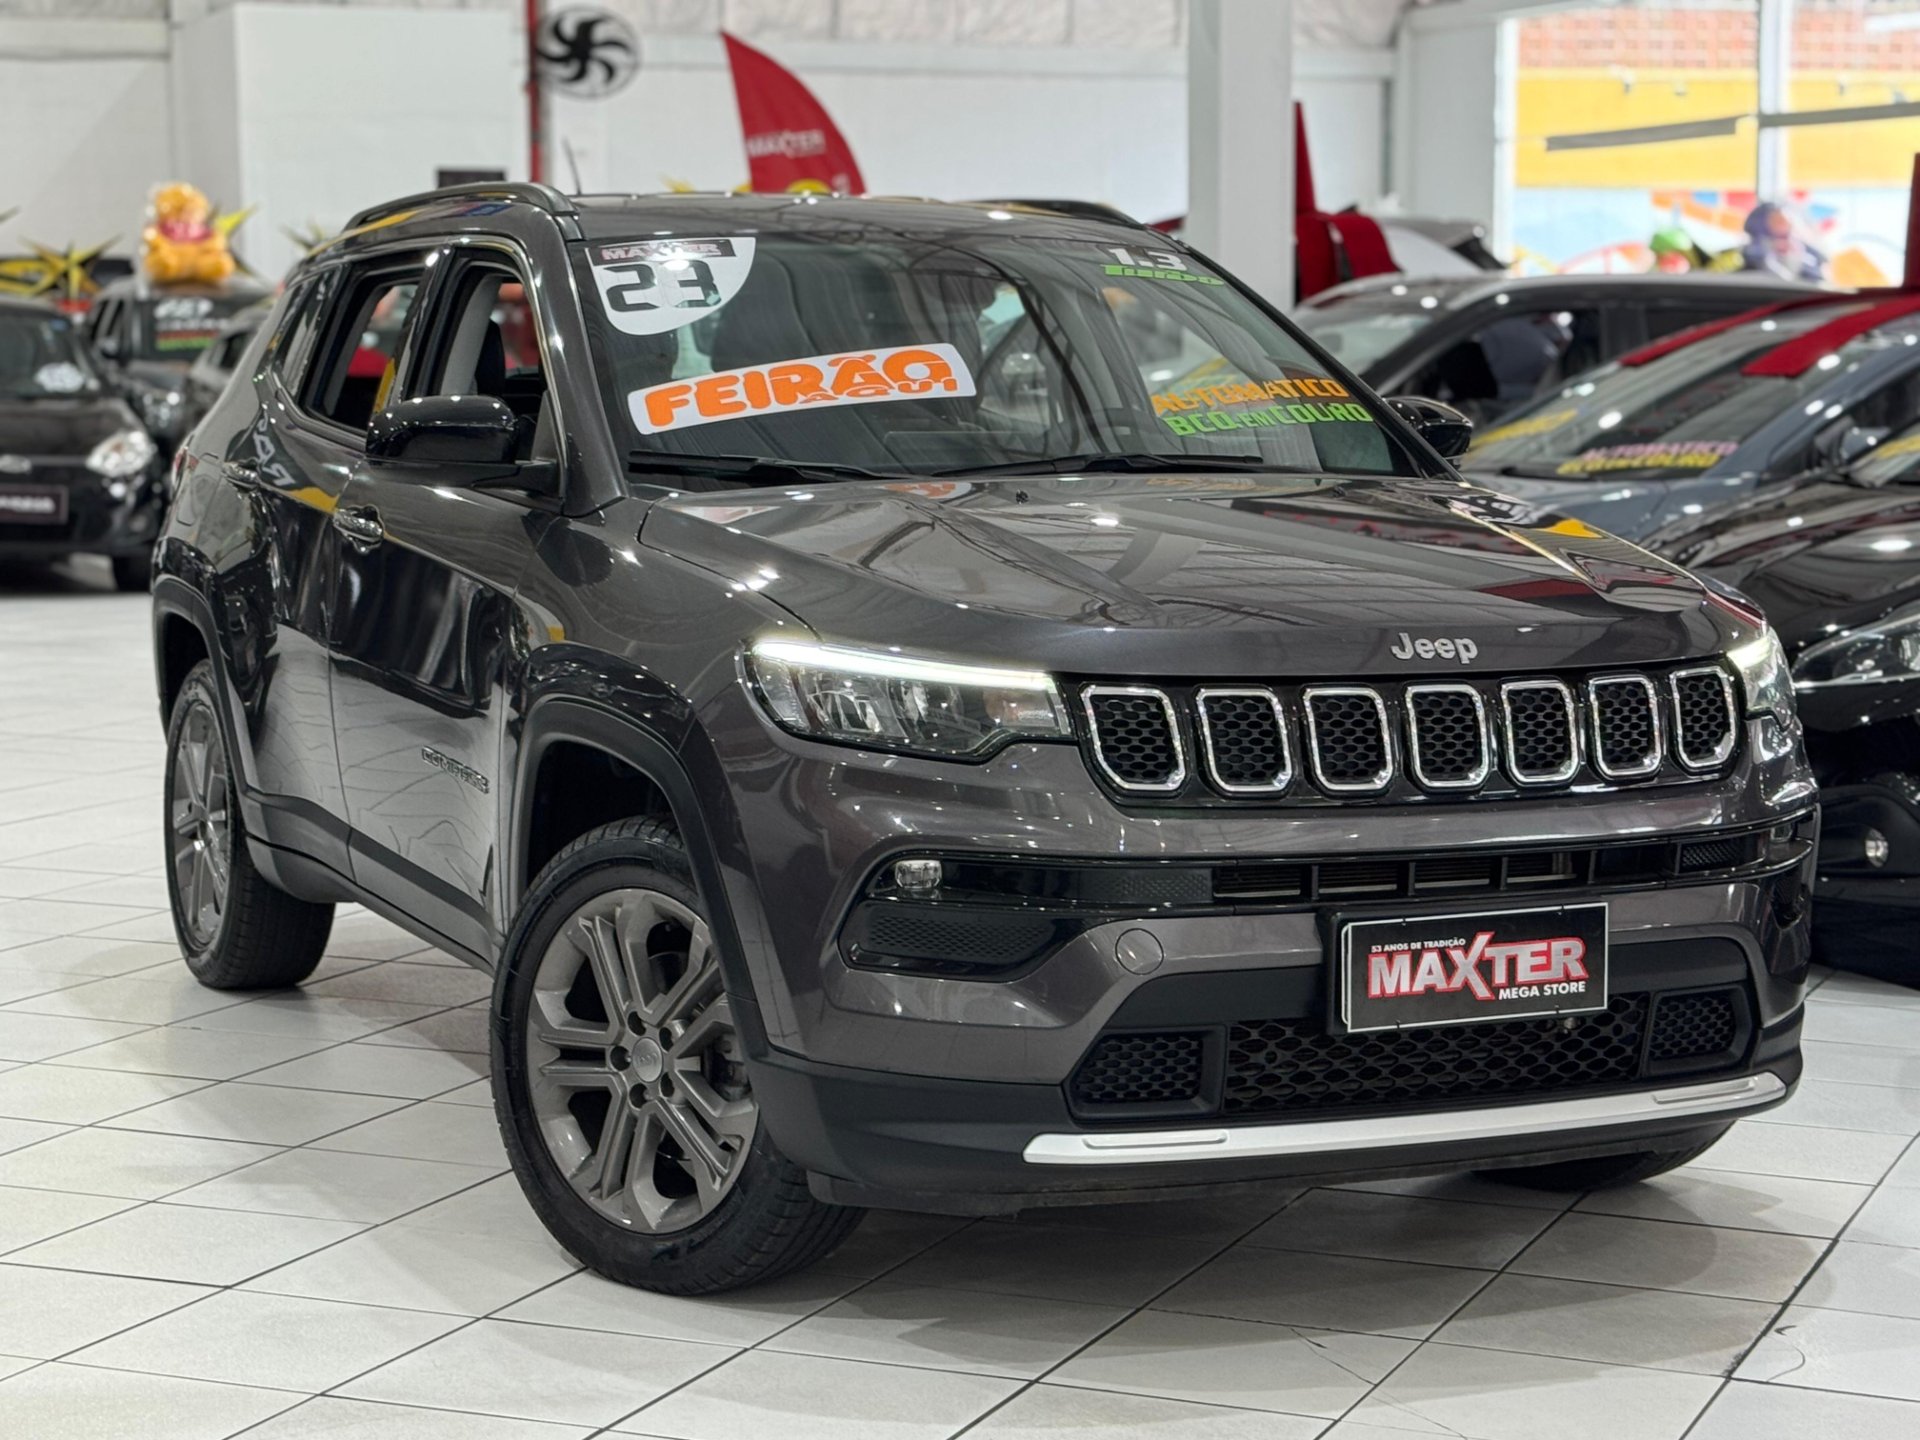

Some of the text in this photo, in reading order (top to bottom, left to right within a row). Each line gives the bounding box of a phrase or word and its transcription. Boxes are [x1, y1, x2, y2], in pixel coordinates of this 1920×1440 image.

[601, 242, 723, 262] MAXER
[1107, 248, 1188, 271] 1.3
[603, 259, 722, 313] 23
[645, 349, 953, 428] FEIRÃO
[1390, 632, 1479, 665] Jeep
[1371, 937, 1467, 954] 53 ANOS DE TRADIÇÃO
[1368, 931, 1589, 1000] MAXTER
[1498, 981, 1587, 1001] MEGA STORE
